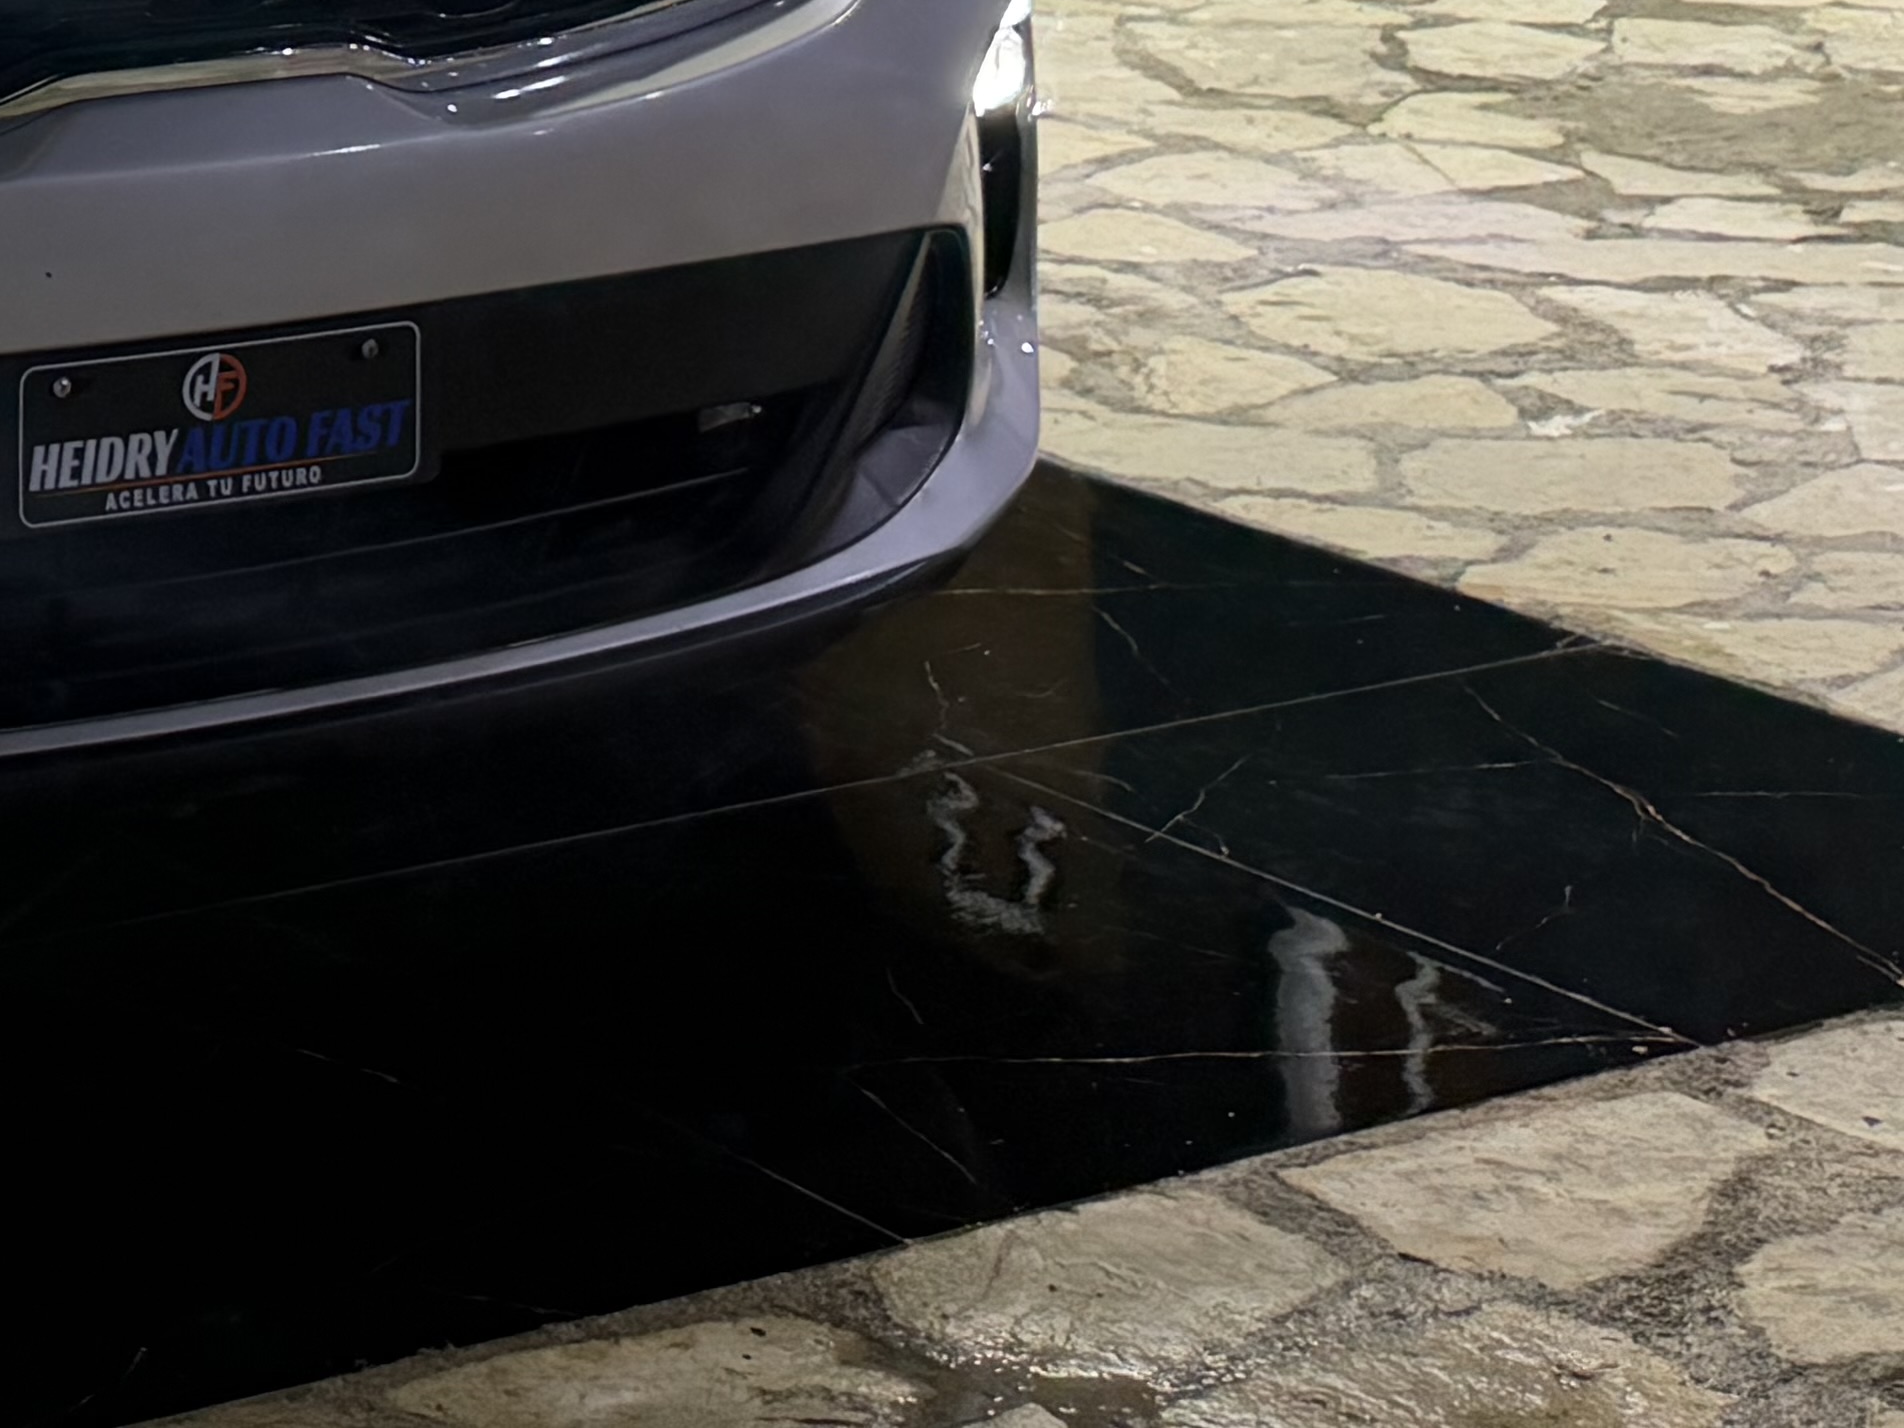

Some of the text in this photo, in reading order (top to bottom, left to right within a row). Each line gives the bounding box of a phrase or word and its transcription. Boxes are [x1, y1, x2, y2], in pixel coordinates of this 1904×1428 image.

[28, 399, 412, 493] HEIDRY AUTO FAST
[104, 465, 322, 512] ACELERA TU FUTURO
